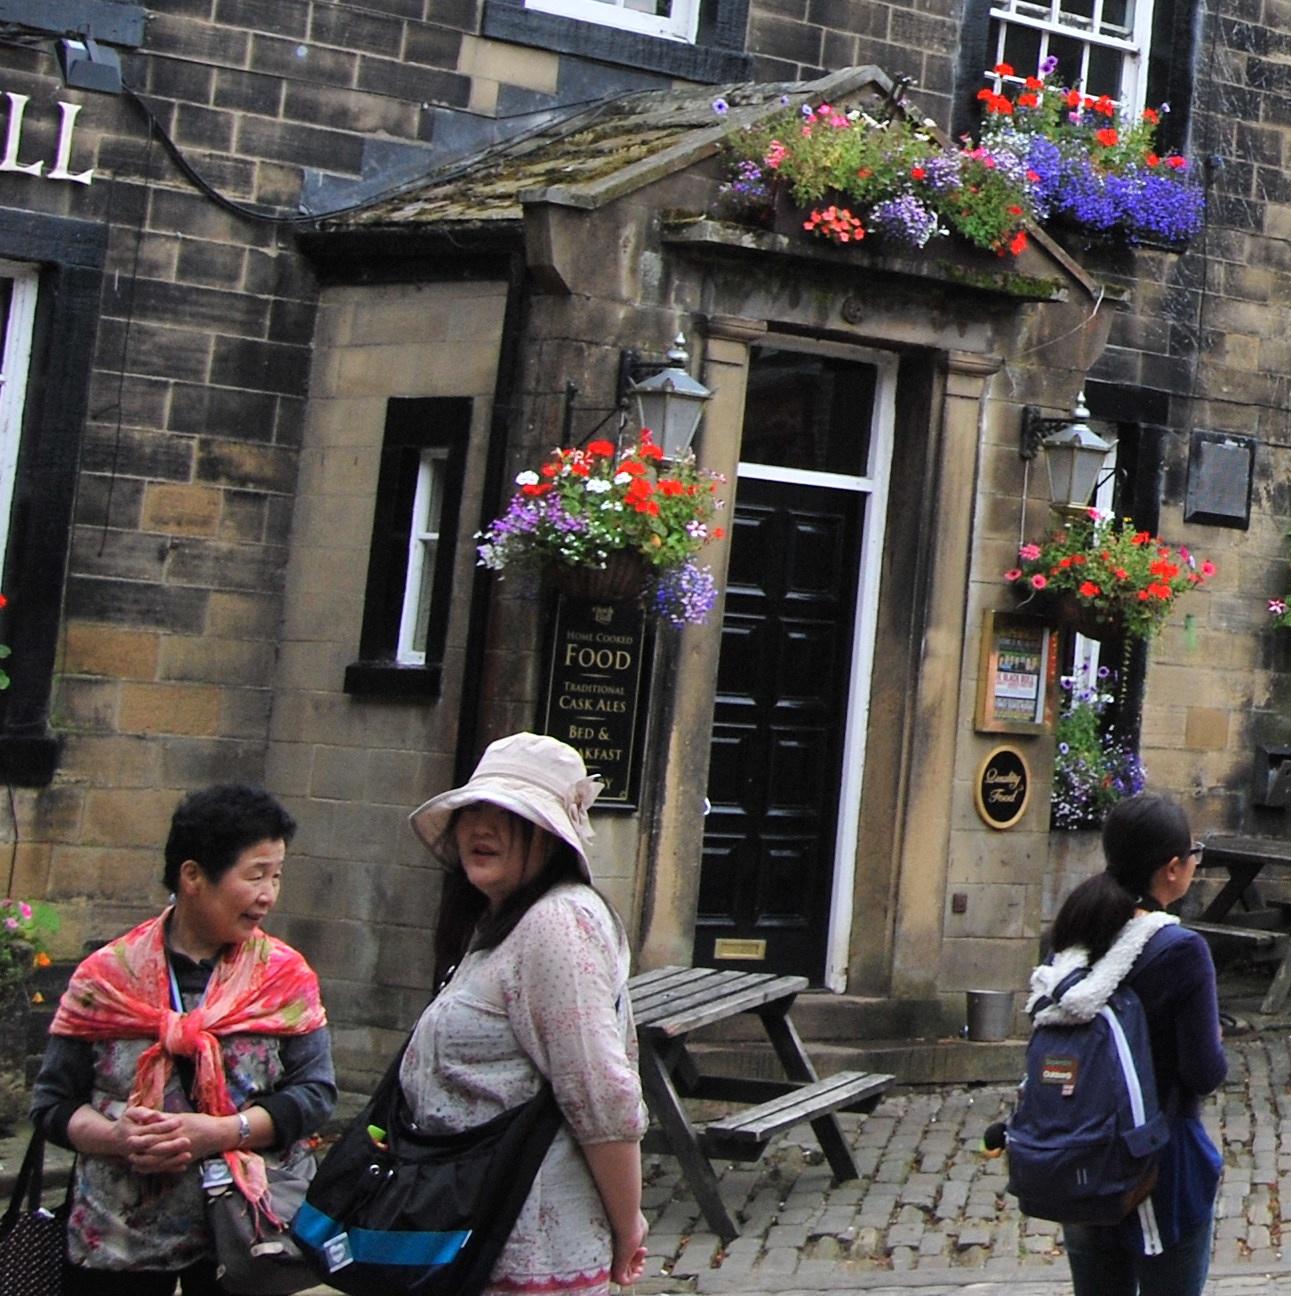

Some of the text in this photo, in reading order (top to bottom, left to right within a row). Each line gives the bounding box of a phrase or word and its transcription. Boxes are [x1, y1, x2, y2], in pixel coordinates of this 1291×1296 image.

[0, 91, 94, 185] LL
[566, 630, 634, 644] HOME COOKED
[564, 643, 631, 670] FOOD
[564, 681, 624, 695] TRADITIONAL
[559, 695, 627, 713] CASK ALES
[569, 725, 611, 741] BED &
[579, 748, 623, 761] AKFAST
[988, 789, 1019, 803] Food
